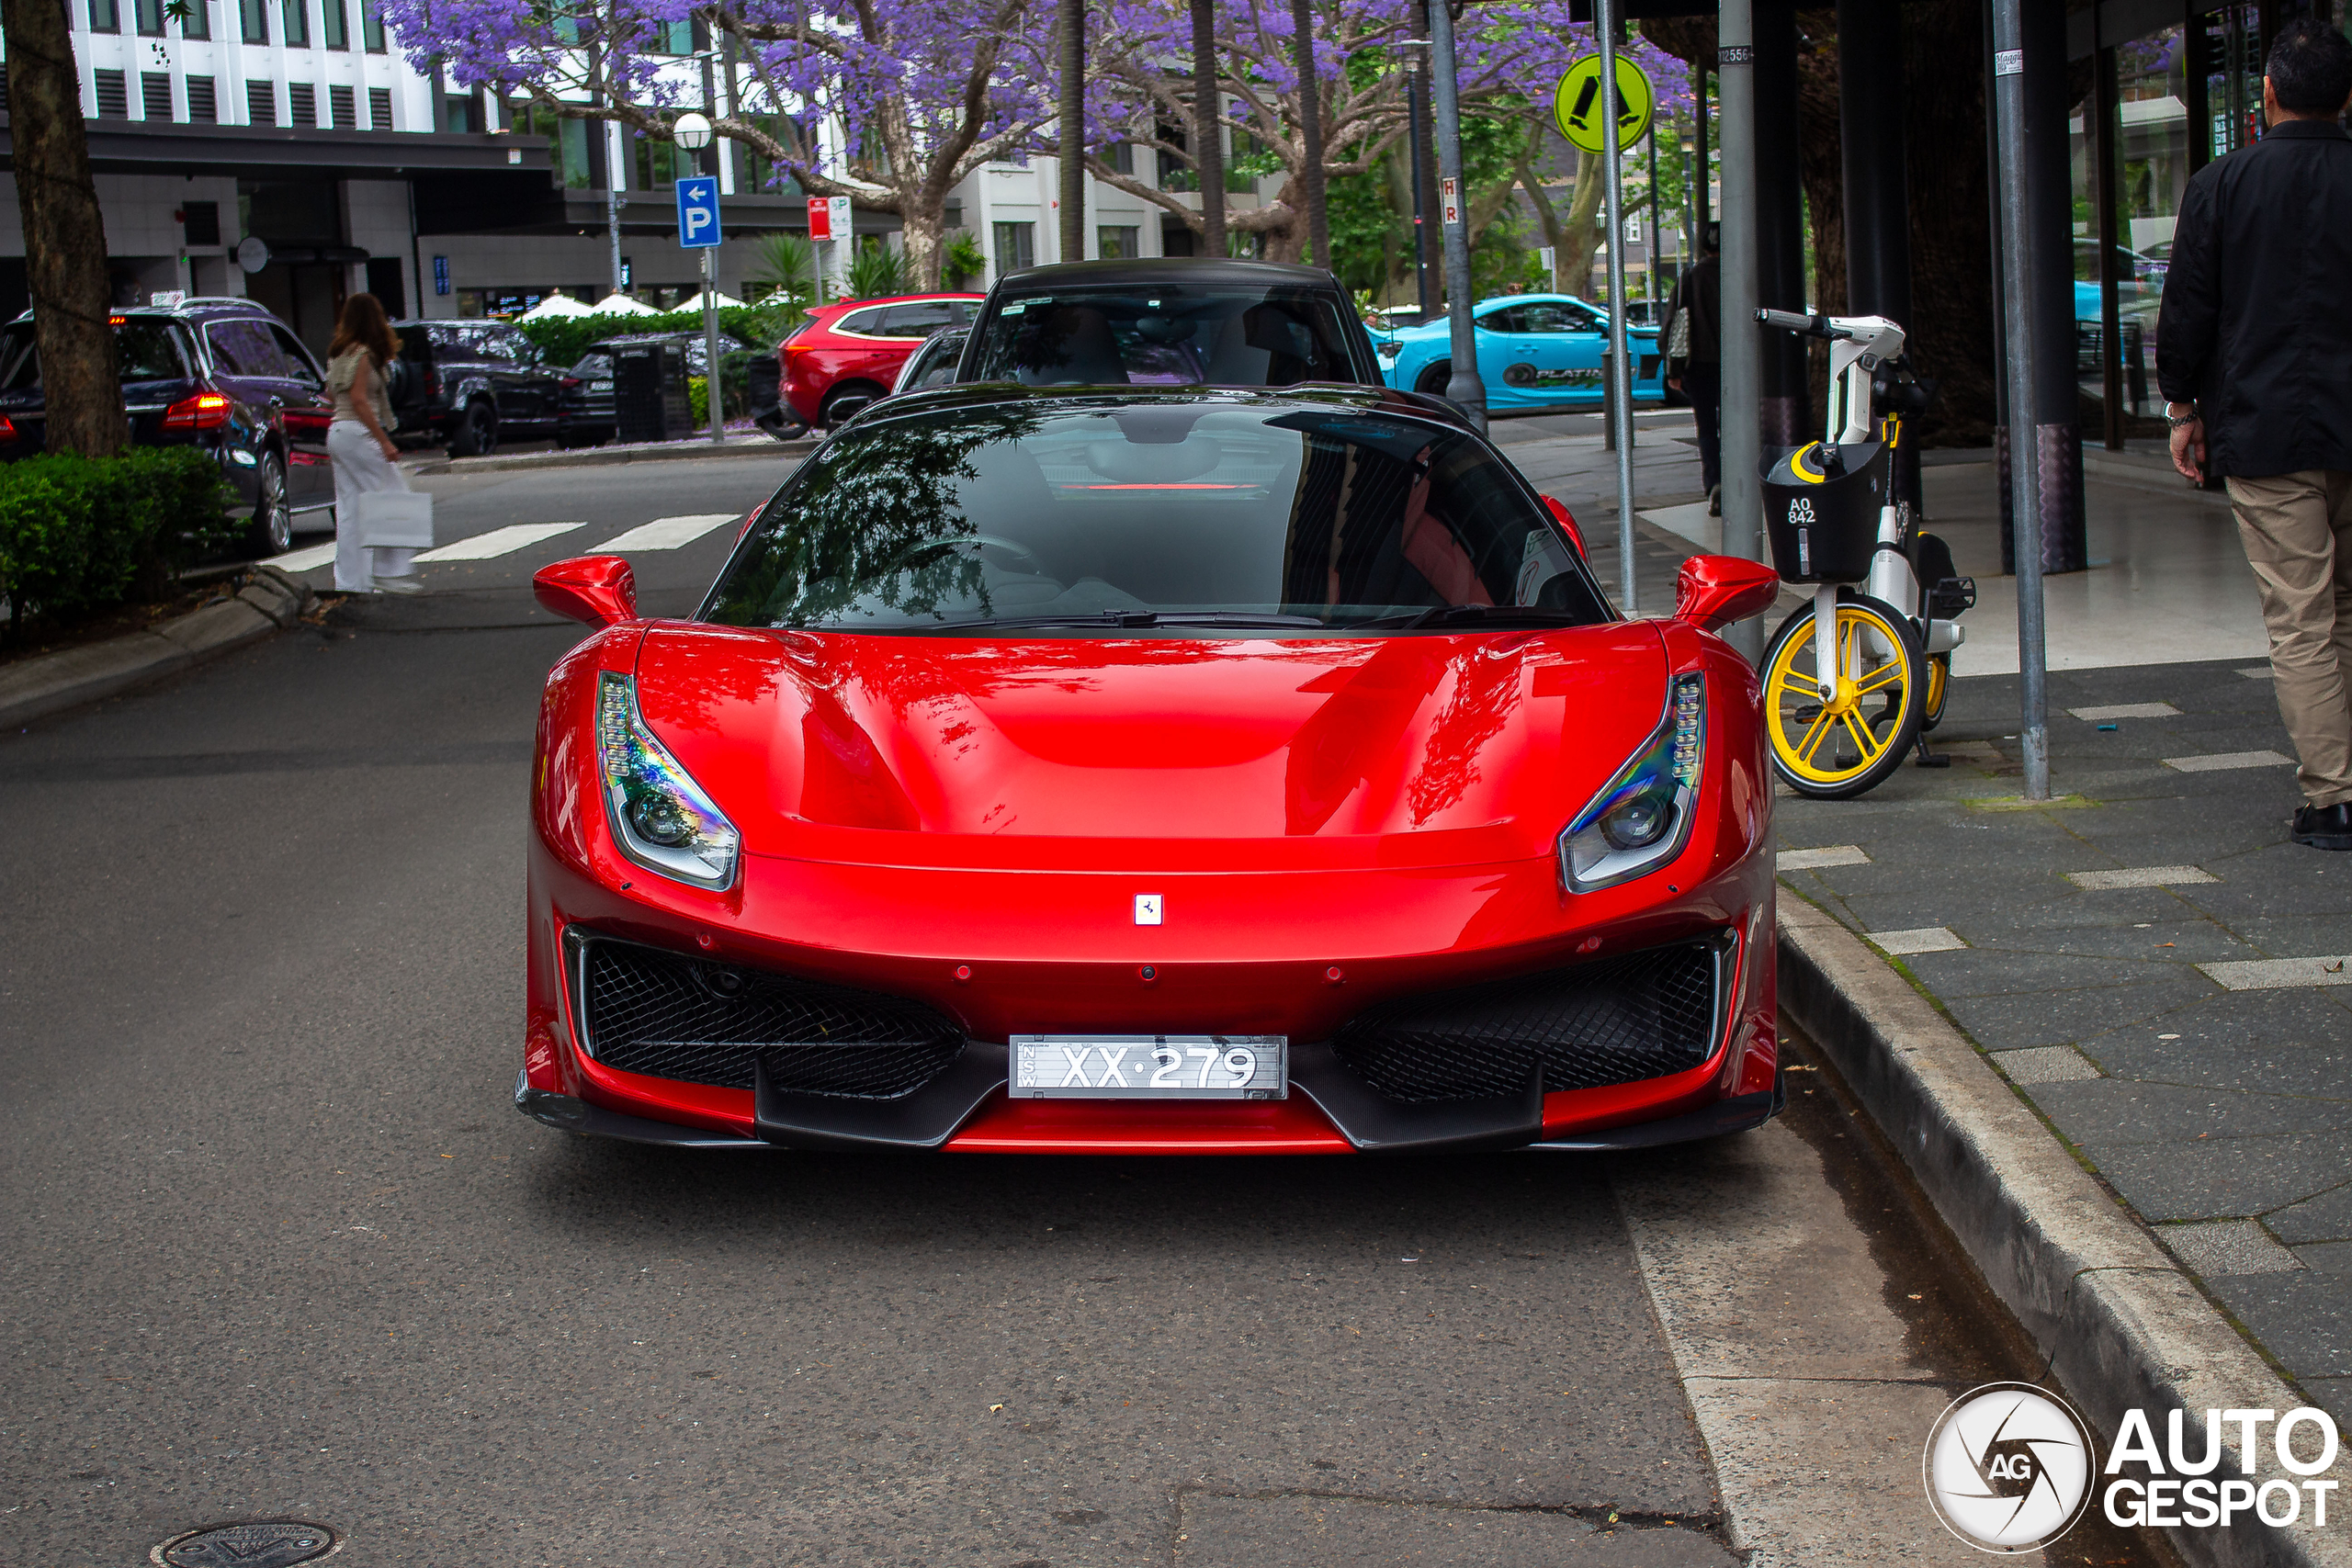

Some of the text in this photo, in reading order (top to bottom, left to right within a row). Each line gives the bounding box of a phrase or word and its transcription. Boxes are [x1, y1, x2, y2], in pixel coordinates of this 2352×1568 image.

[1444, 180, 1454, 195] H
[1446, 206, 1456, 220] R
[685, 207, 712, 239] P
[1536, 367, 1636, 378] PLATIN
[1788, 510, 1815, 524] 842
